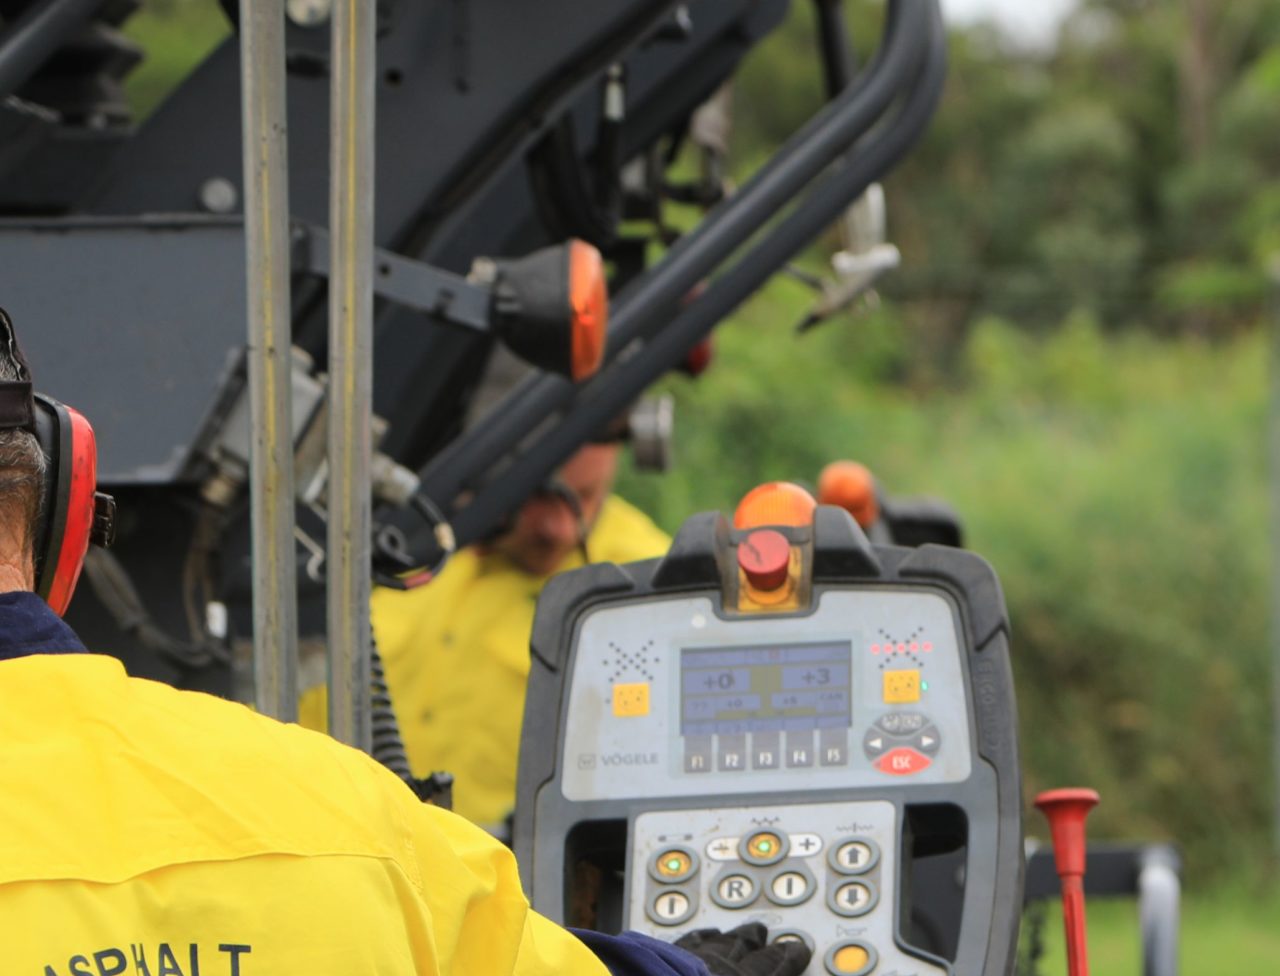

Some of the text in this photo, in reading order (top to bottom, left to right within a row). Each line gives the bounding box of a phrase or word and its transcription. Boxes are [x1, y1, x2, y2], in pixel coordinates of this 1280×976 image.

[691, 755, 704, 770] F1
[725, 753, 739, 768] F2
[759, 751, 773, 766] F3
[793, 750, 807, 764] F4
[827, 748, 841, 763] F5
[727, 880, 744, 899] R
